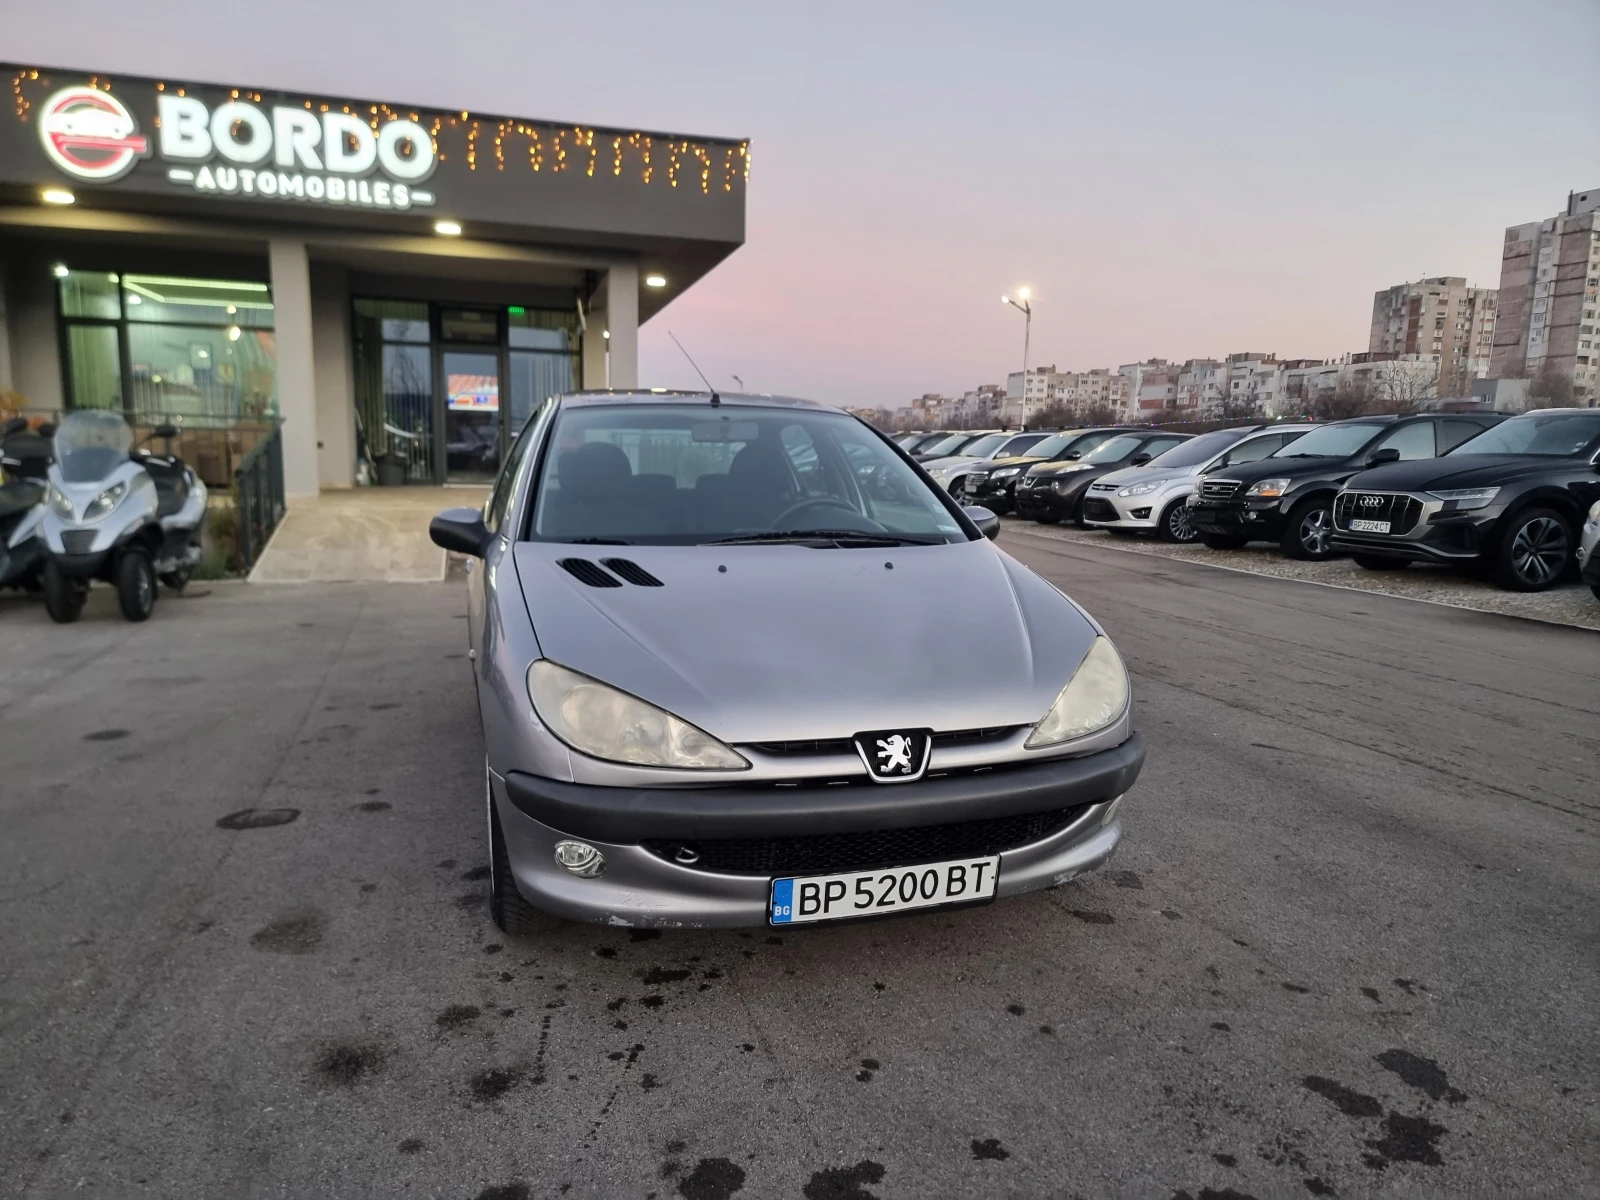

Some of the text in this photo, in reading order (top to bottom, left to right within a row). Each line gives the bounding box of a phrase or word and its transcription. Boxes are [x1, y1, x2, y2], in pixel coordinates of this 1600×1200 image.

[158, 95, 435, 178] BORDO
[195, 166, 410, 207] AUTOMOBILES
[1353, 520, 1389, 531] BP 2224 CT
[799, 862, 991, 916] BP 5200 BT
[774, 905, 790, 917] BG
